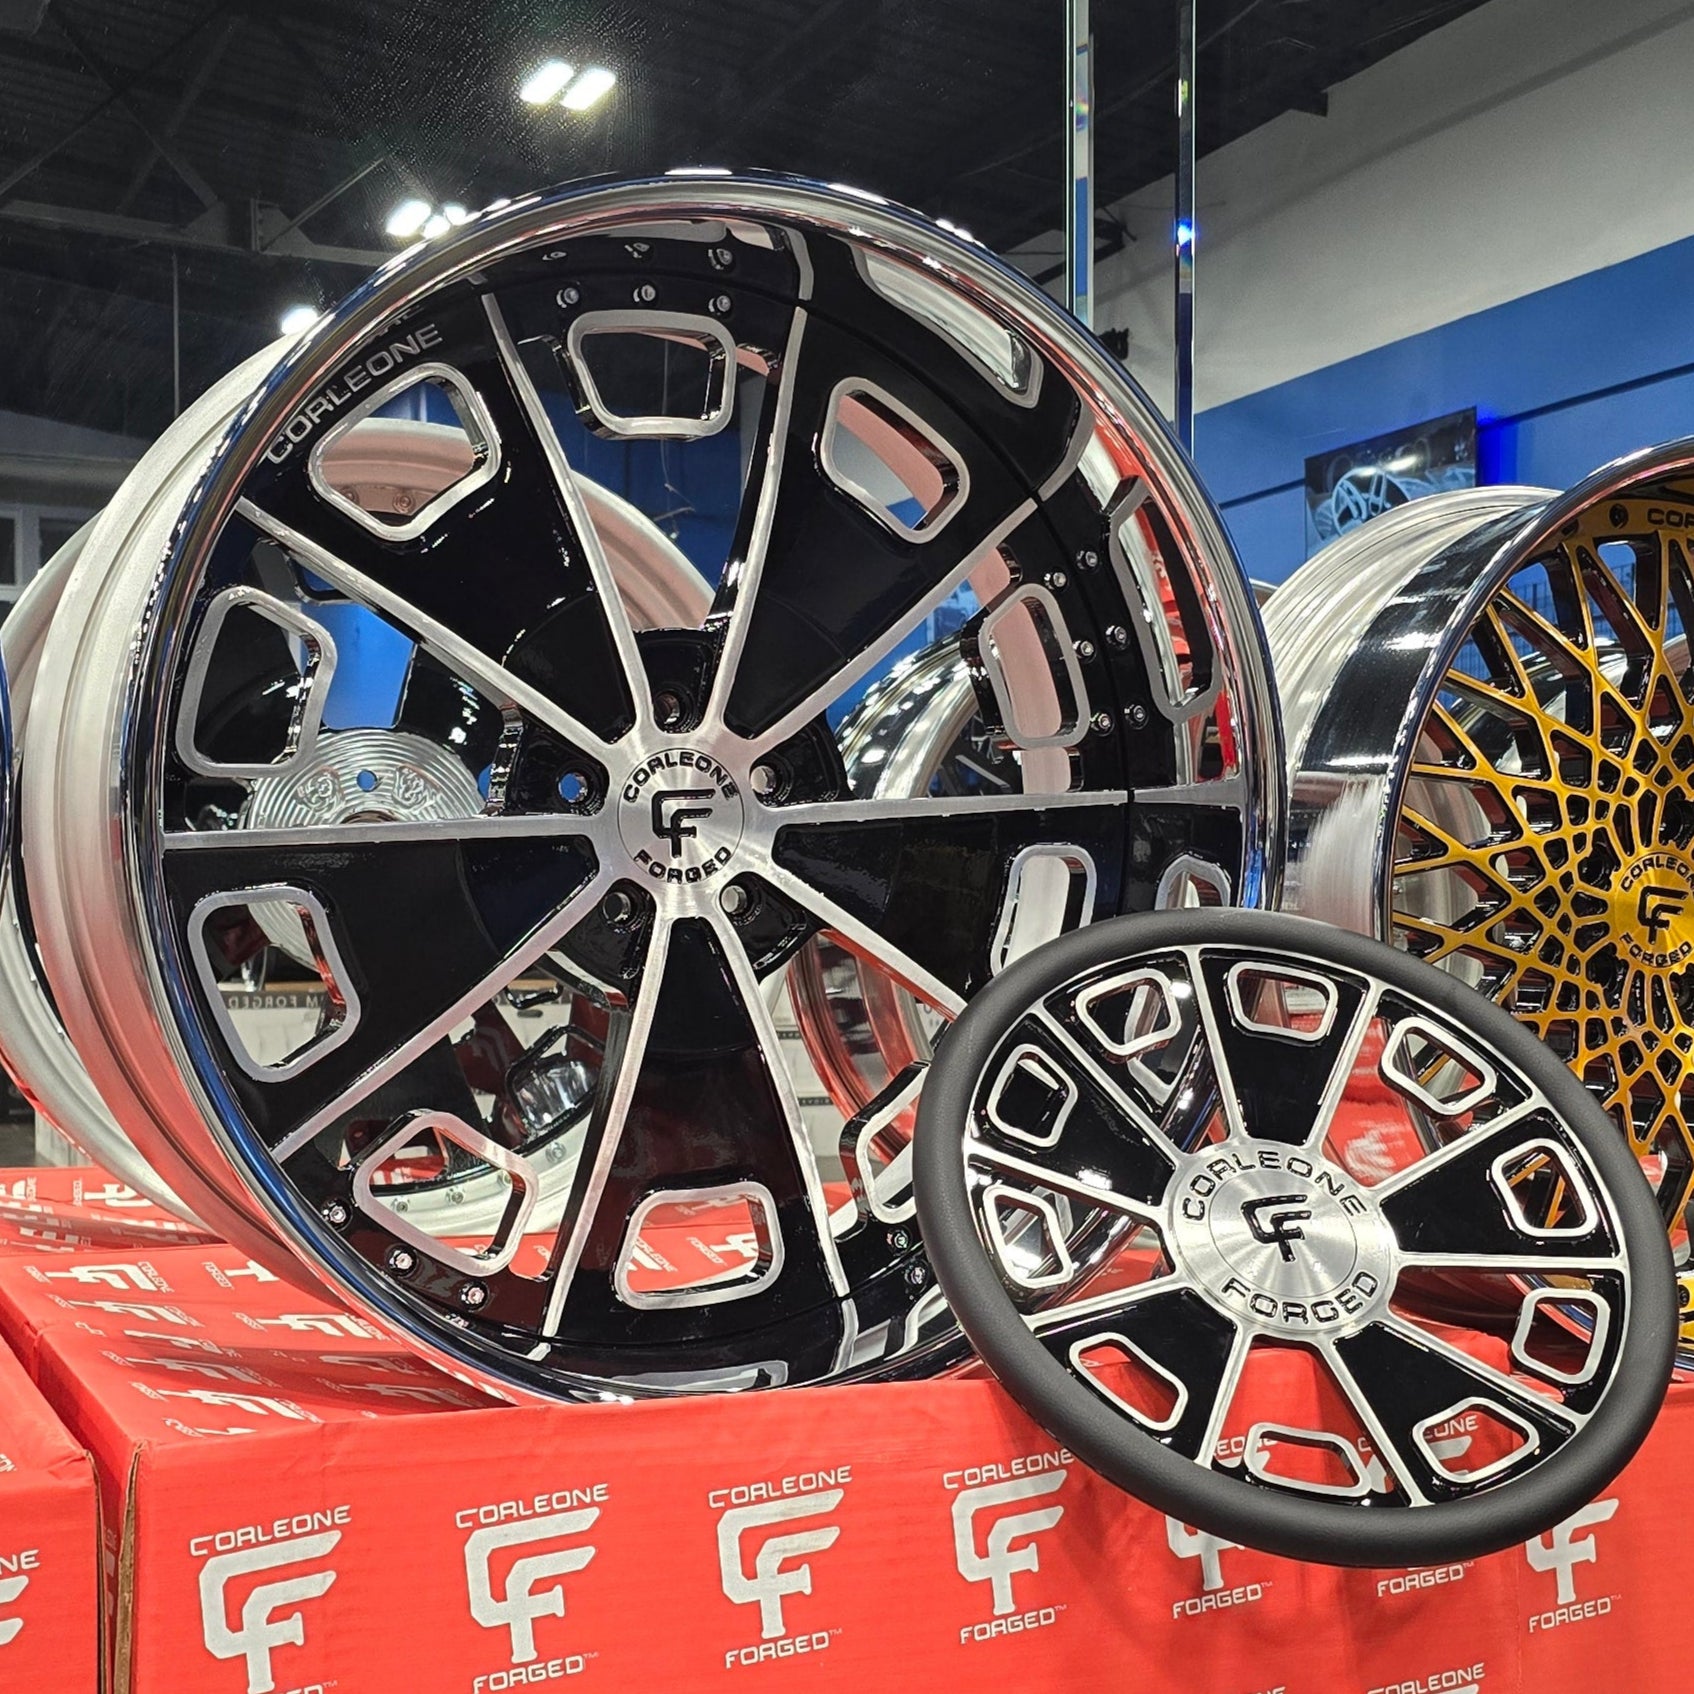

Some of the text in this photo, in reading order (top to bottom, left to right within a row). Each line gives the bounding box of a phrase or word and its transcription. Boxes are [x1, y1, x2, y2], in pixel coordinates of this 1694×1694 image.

[265, 323, 443, 464] CORLEONE
[623, 751, 739, 803] CORLEONE
[633, 846, 732, 885] FORGED
[1619, 932, 1692, 968] FORGED
[1182, 1150, 1368, 1221] CORLEONE
[1221, 1271, 1379, 1324] FORGED
[708, 1465, 853, 1508] CORLEONE
[943, 1448, 1075, 1489] CORLEONE
[455, 1483, 610, 1529] CORLEONE
[190, 1505, 352, 1556] CORLEONE
